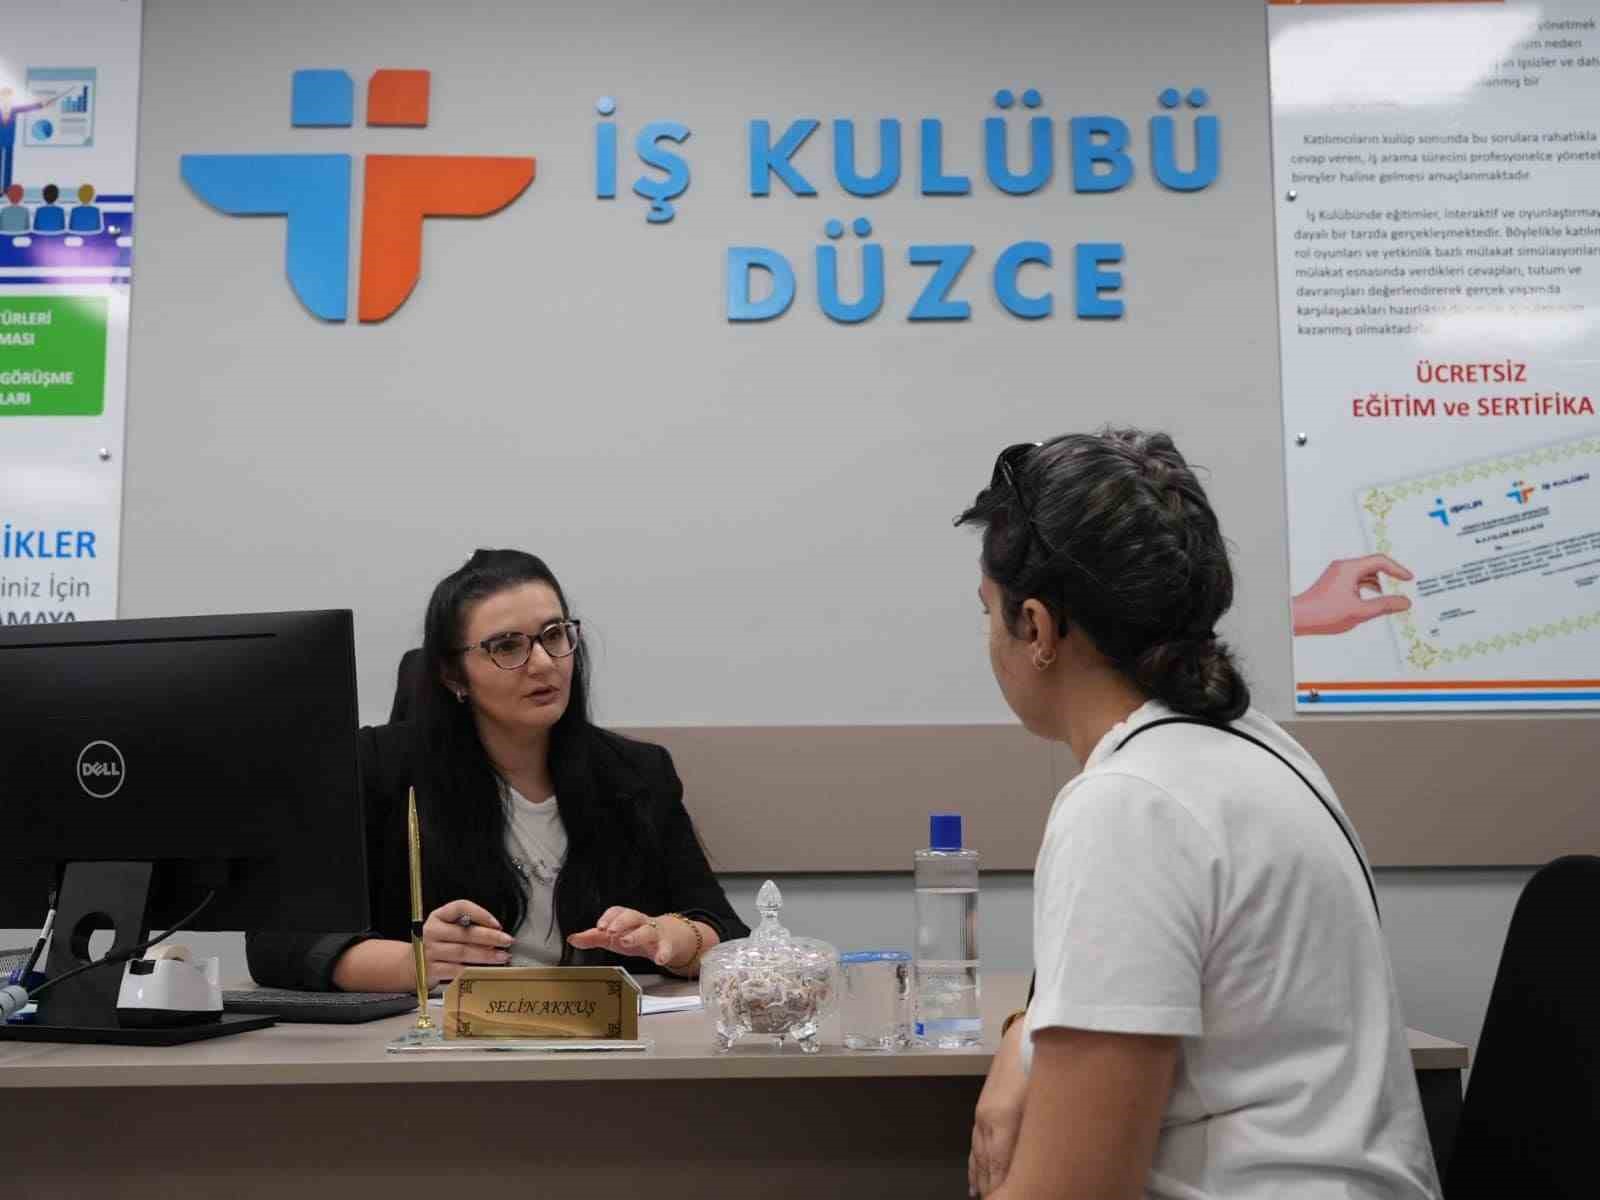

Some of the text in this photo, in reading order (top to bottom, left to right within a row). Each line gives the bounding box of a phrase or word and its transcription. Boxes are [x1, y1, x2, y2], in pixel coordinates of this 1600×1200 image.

[1472, 133, 1488, 144] bu
[1490, 132, 1538, 143] sorulara
[595, 87, 1222, 223] İŞ KULÜBÜ
[1291, 154, 1326, 166] cevap
[1381, 154, 1417, 163] arama
[1421, 151, 1467, 162] sürecini
[1470, 150, 1552, 163] profesyonelce
[1291, 172, 1336, 184] bireyler
[1340, 171, 1376, 182] haline
[1379, 171, 1424, 184] gelmesi
[1444, 207, 1499, 219] interaktif
[1502, 209, 1516, 218] ve
[1331, 229, 1347, 240] bir
[1351, 229, 1388, 240] tarzda
[1294, 246, 1311, 257] rol
[1365, 249, 1379, 257] ve
[1383, 246, 1432, 259] yetkinlik
[1465, 245, 1514, 257] mülakat
[726, 216, 1126, 326] DÜZCE
[1295, 266, 1344, 278] mülakat
[1346, 265, 1406, 277] esnasında
[1527, 264, 1565, 276] tutum
[1568, 265, 1582, 275] ve
[1466, 284, 1504, 299] gerçek
[1297, 323, 1352, 337] kazanmış
[1416, 359, 1527, 383] ÜCRETSİZ
[1352, 392, 1596, 417] EĞİTİM ve SERTİFİKA
[49, 571, 91, 603] İçin
[82, 761, 121, 777] DELL
[485, 993, 598, 1019] SELİN AKKUŞ
